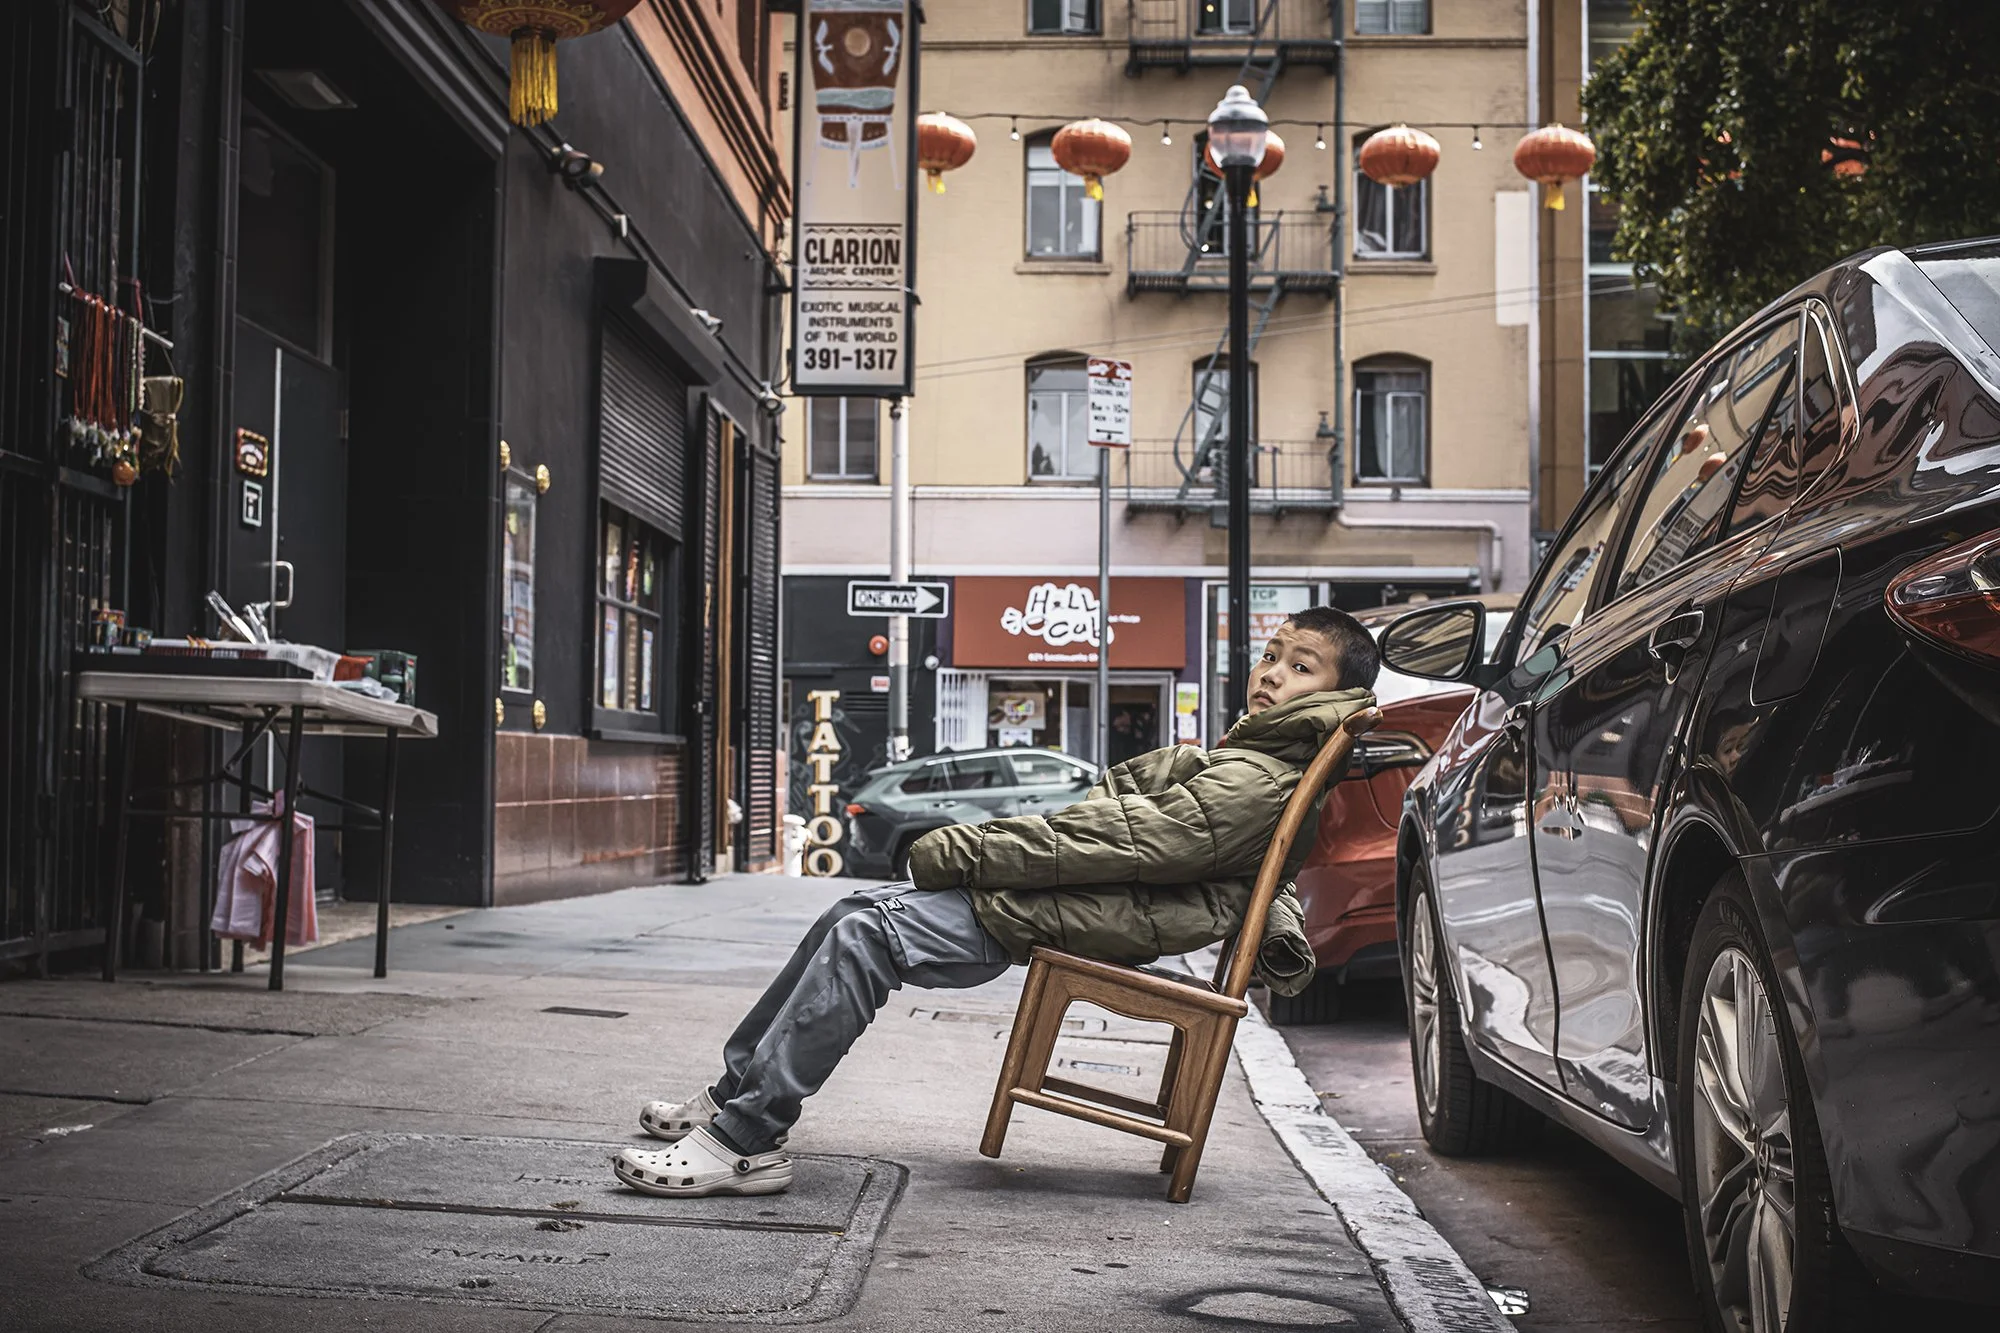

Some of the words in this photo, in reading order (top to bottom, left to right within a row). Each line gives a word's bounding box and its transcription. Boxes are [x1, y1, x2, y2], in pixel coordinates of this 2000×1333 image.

[804, 238, 901, 265] CLARION
[852, 267, 894, 276] CENTER
[801, 301, 843, 313] EXOTIC
[848, 302, 901, 313] MUSICAL
[808, 316, 893, 328] INSTRUMENTS
[804, 331, 820, 342] OF
[827, 331, 848, 342] THE
[854, 331, 897, 343] WORLD
[804, 348, 897, 370] 391-1317
[859, 591, 885, 606] ONE
[891, 593, 918, 605] WAY
[807, 689, 844, 878] TATTOO
